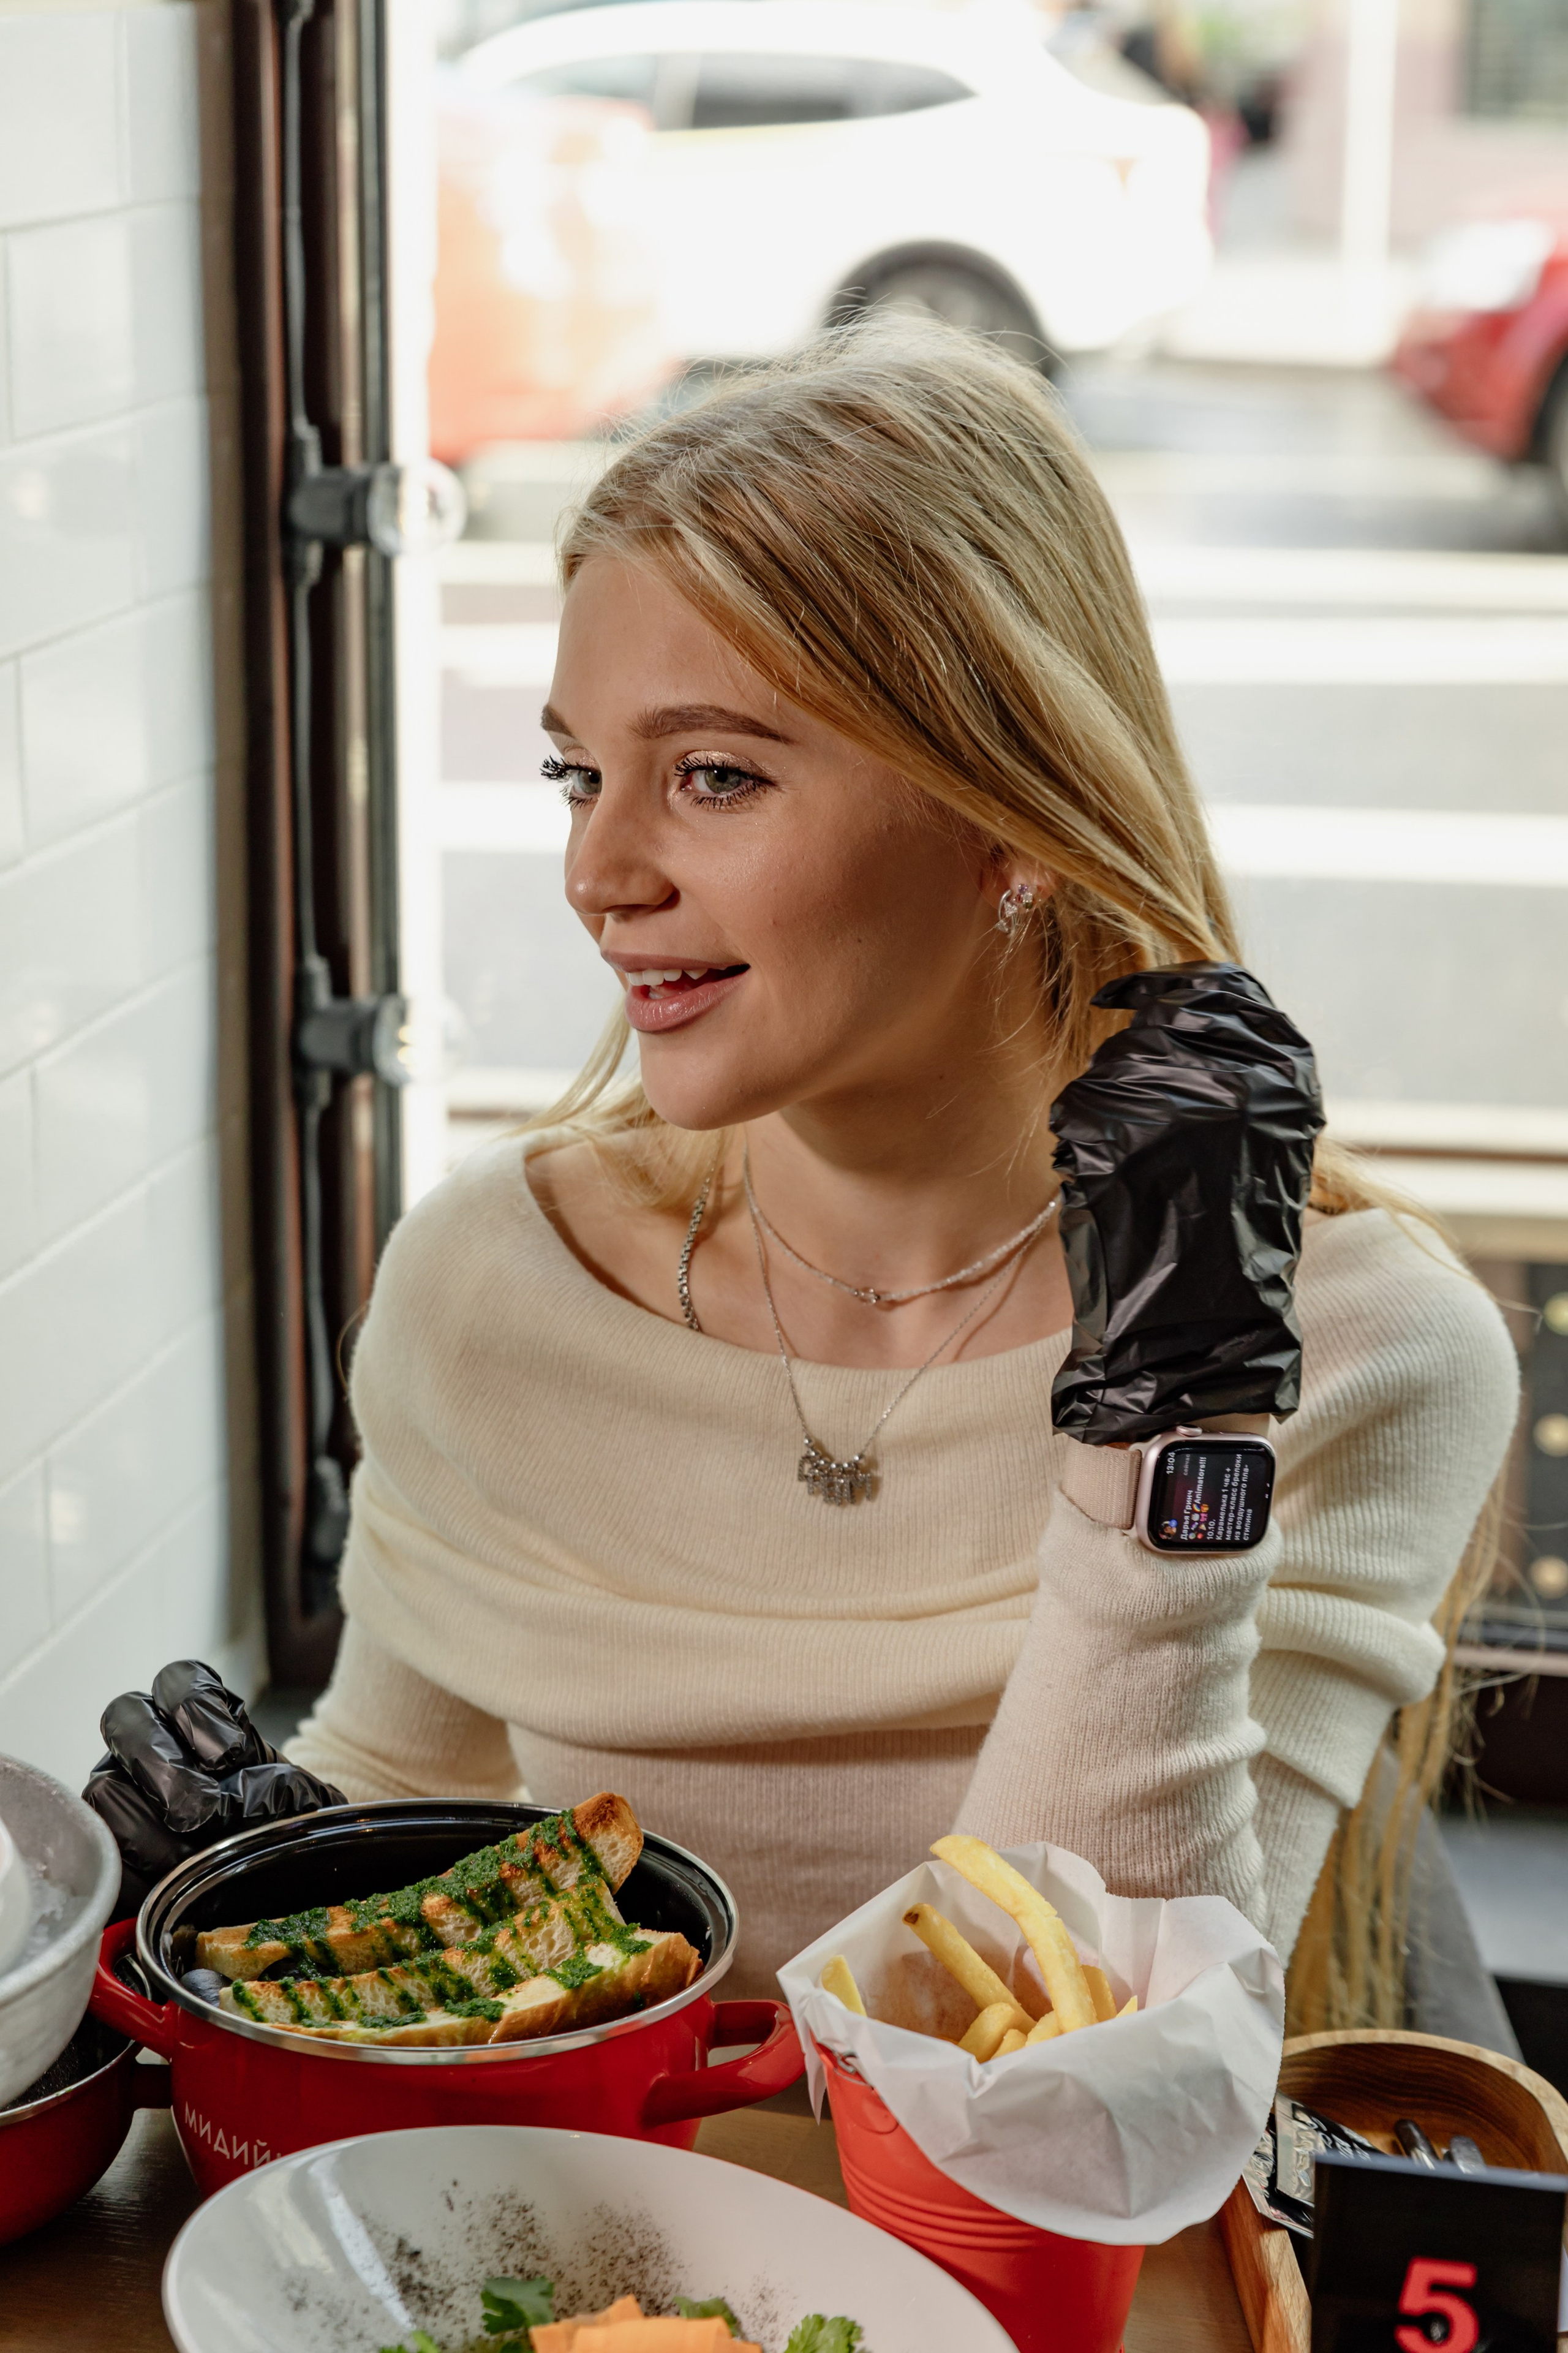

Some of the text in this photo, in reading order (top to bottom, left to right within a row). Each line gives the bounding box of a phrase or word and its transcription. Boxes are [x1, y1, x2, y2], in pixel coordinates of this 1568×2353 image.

[1166, 1452, 1175, 1475] 13:04
[1180, 1490, 1193, 1540] Дарья Гринч
[1215, 1494, 1228, 1540] Карамелька
[1225, 1454, 1242, 1541] мастер-класс брелоки
[1235, 1483, 1248, 1530] воздушного
[1234, 1531, 1241, 1541] из
[1243, 1509, 1253, 1541] стилина
[185, 2101, 282, 2169] МИДИЙ
[1394, 2256, 1479, 2353] 5
